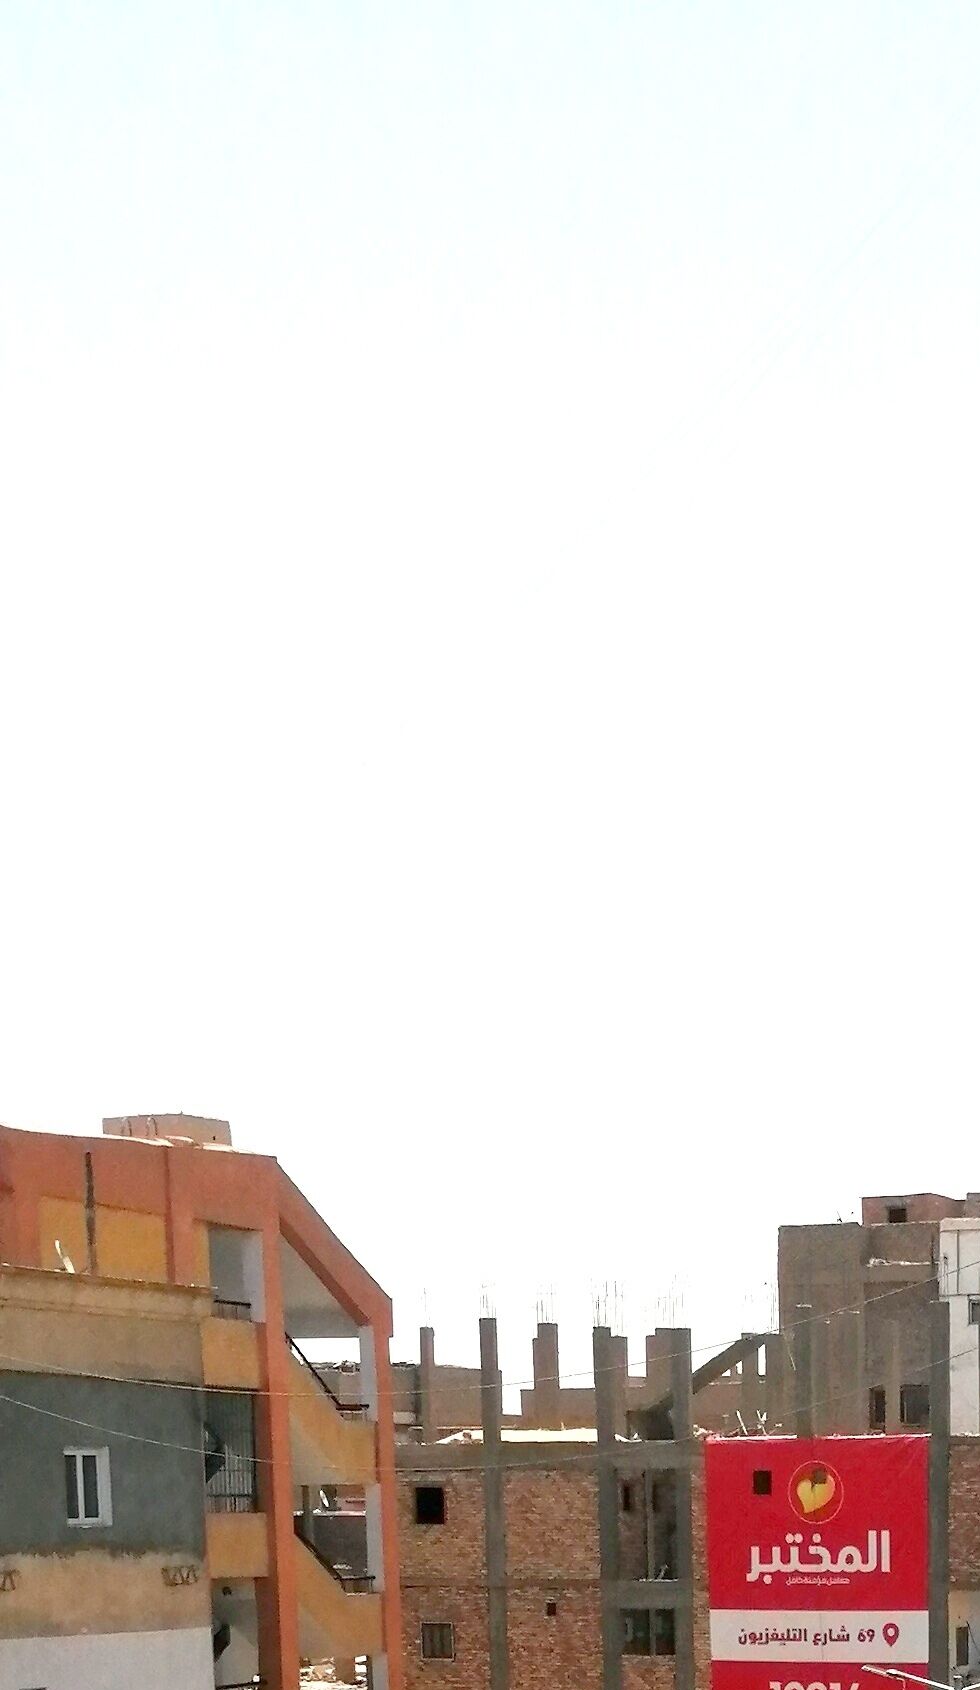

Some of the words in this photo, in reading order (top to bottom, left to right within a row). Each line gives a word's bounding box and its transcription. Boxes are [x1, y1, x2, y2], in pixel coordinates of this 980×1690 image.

[745, 1529, 891, 1585] المختبر
[738, 1627, 808, 1647] التليفزيون
[812, 1625, 850, 1646] شارع
[857, 1628, 875, 1643] 69
